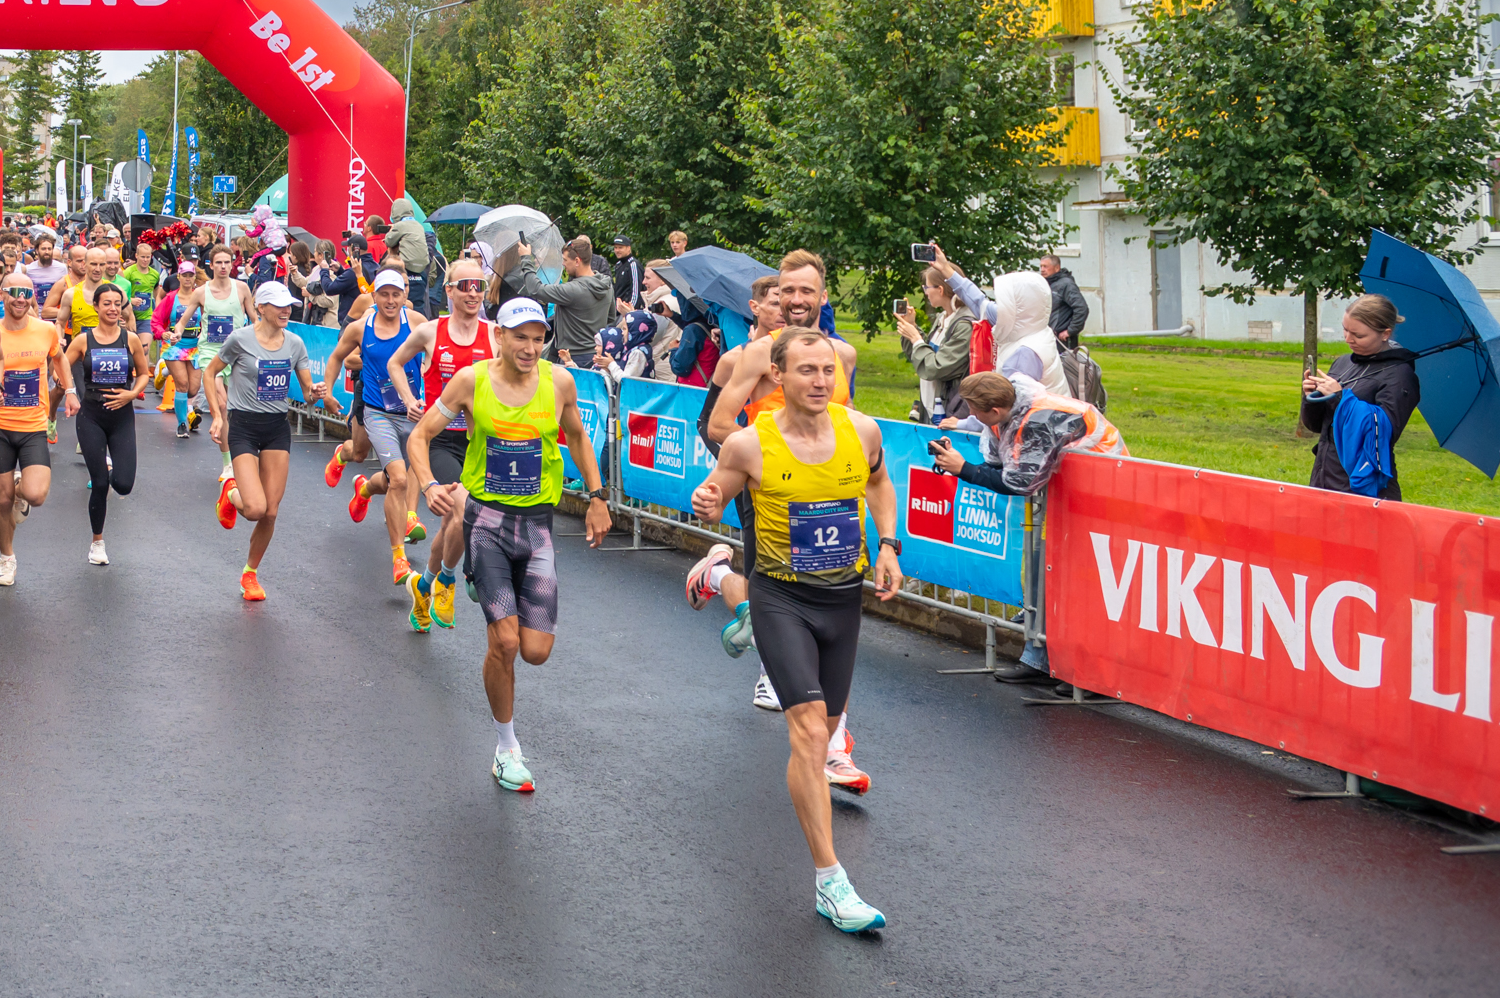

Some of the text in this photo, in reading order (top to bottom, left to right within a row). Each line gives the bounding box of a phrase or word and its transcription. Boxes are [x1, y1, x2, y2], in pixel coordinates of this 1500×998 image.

[249, 10, 336, 92] Be 1st
[347, 157, 366, 237] RTLAND
[217, 325, 223, 334] 4
[99, 360, 121, 372] 234
[18, 384, 26, 394] 5
[266, 374, 286, 387] 300
[632, 434, 651, 448] Rimi
[658, 424, 680, 441] EESTI
[657, 439, 683, 456] LINNA-
[509, 460, 519, 476] 1
[655, 454, 682, 469] JOOKSUD
[815, 501, 842, 510] SPORTLAND
[911, 496, 943, 515] Rimi
[960, 487, 998, 509] EESTI
[957, 505, 1003, 530] LINNA-
[814, 526, 840, 547] 12
[956, 525, 1002, 546] JOOKSUD
[1089, 531, 1495, 723] VIKING LI
